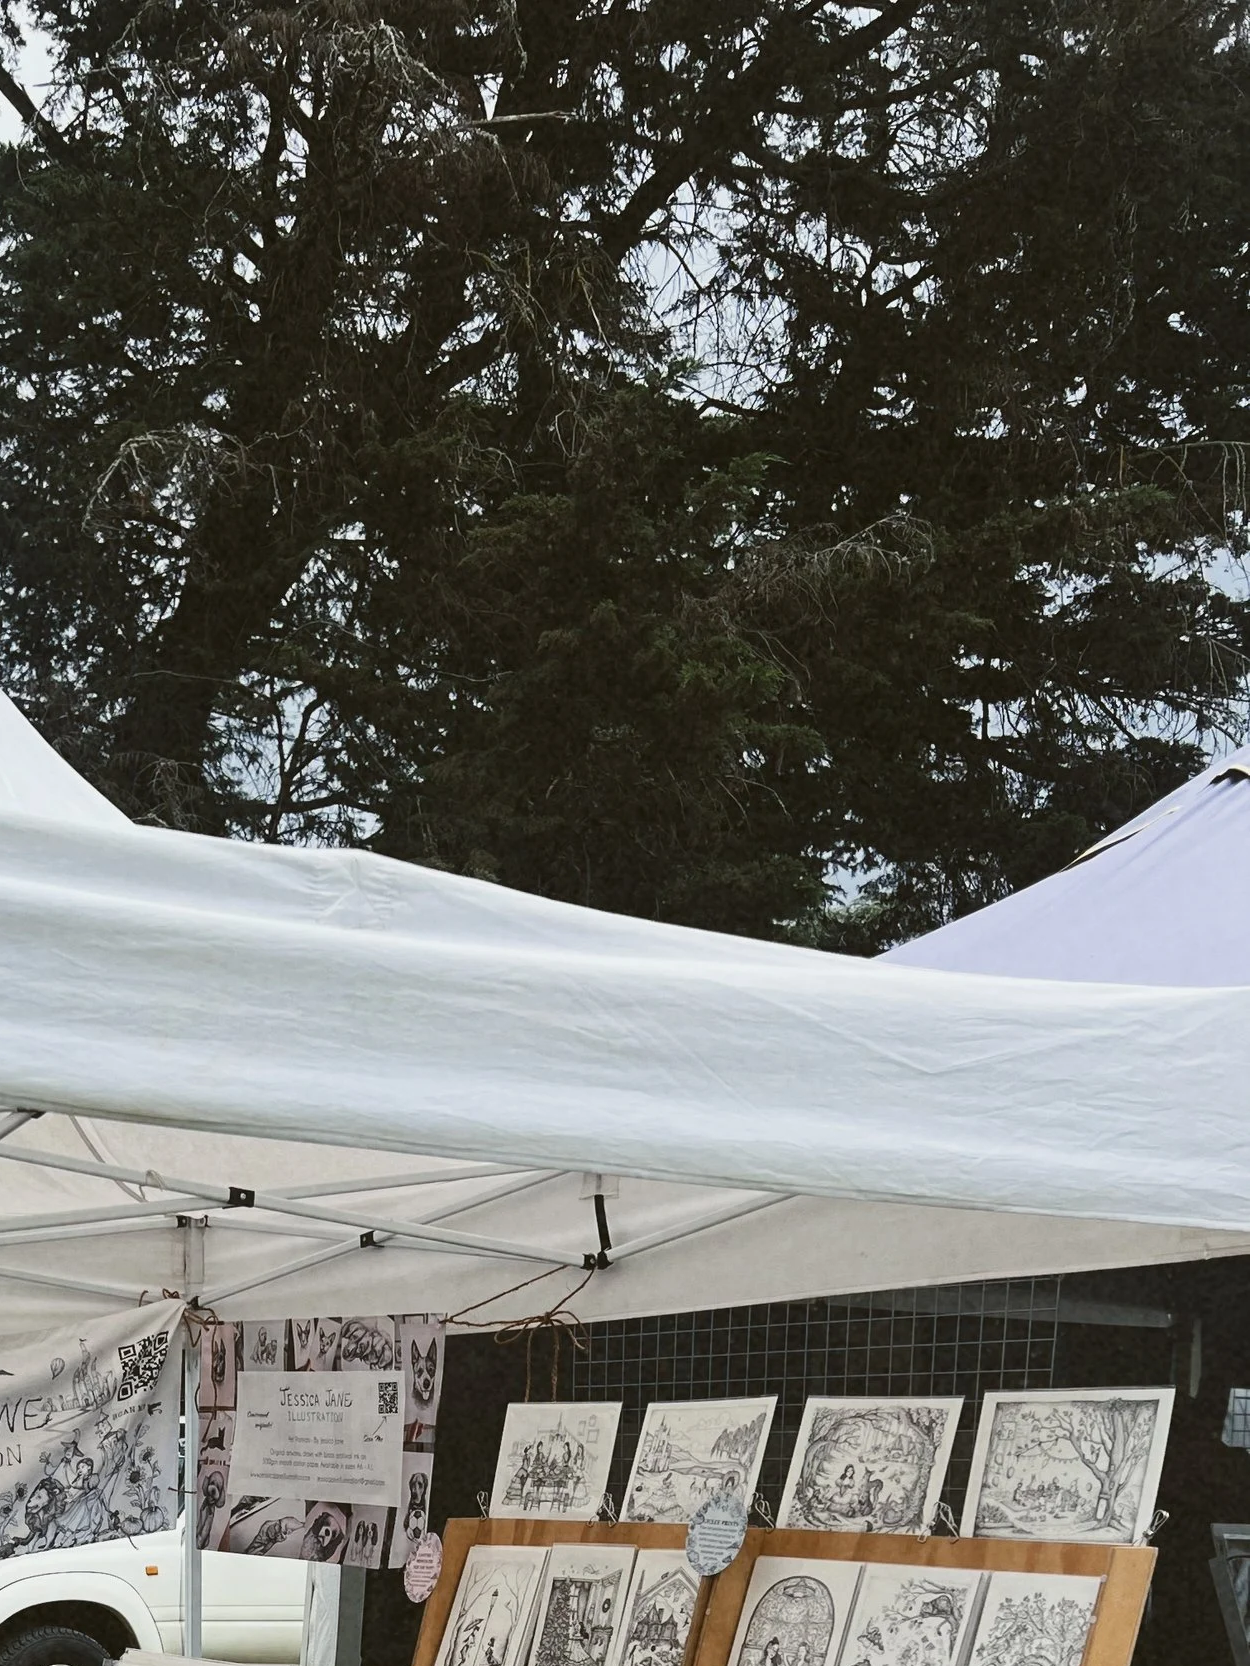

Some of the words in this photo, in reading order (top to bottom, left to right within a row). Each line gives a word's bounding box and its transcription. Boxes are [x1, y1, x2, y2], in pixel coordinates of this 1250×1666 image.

[279, 1386, 320, 1408] JESSICA
[325, 1388, 353, 1408] JANE
[288, 1410, 344, 1423] ILLUSTRATION
